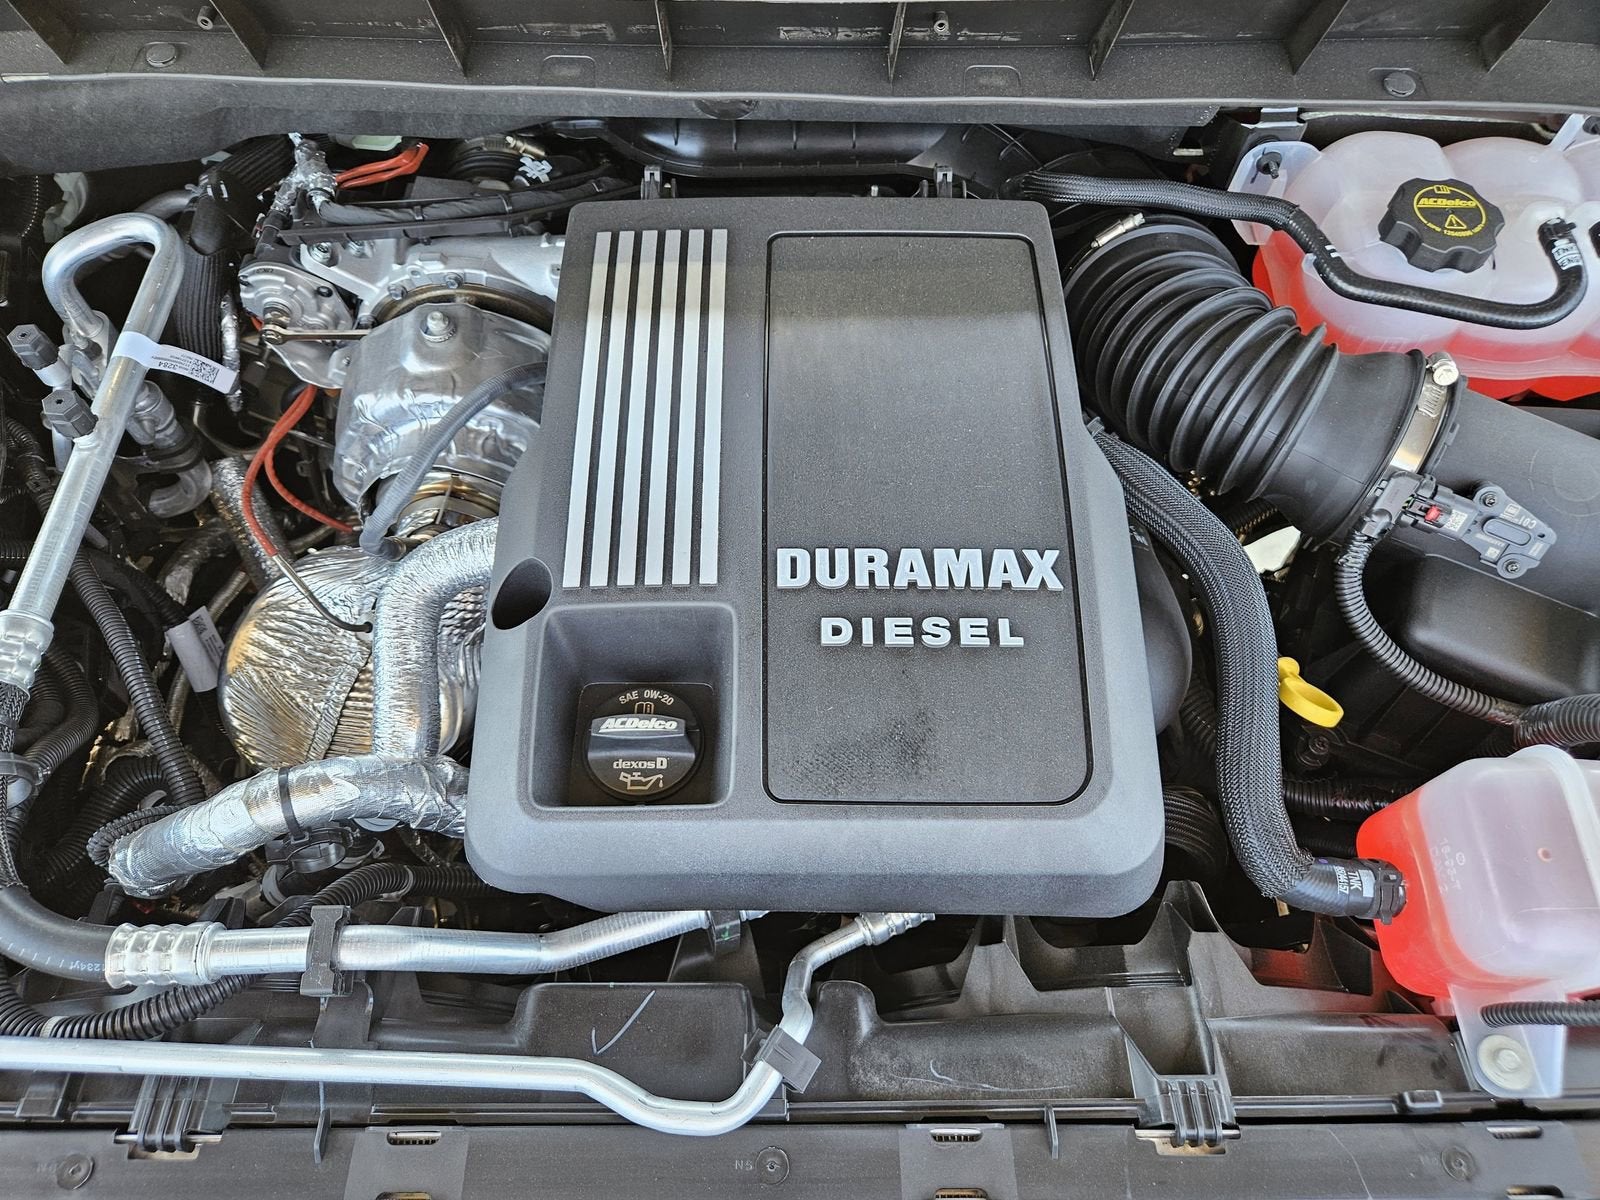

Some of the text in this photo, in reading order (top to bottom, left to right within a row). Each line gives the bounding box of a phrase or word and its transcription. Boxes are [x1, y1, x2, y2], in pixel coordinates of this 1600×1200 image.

[1417, 197, 1477, 208] ACDelco
[776, 548, 1064, 591] DURAMAX
[820, 616, 1025, 648] DIESEL
[619, 689, 675, 706] SAE 0W-20
[599, 717, 678, 732] ACDelco
[1347, 870, 1362, 891] TNK
